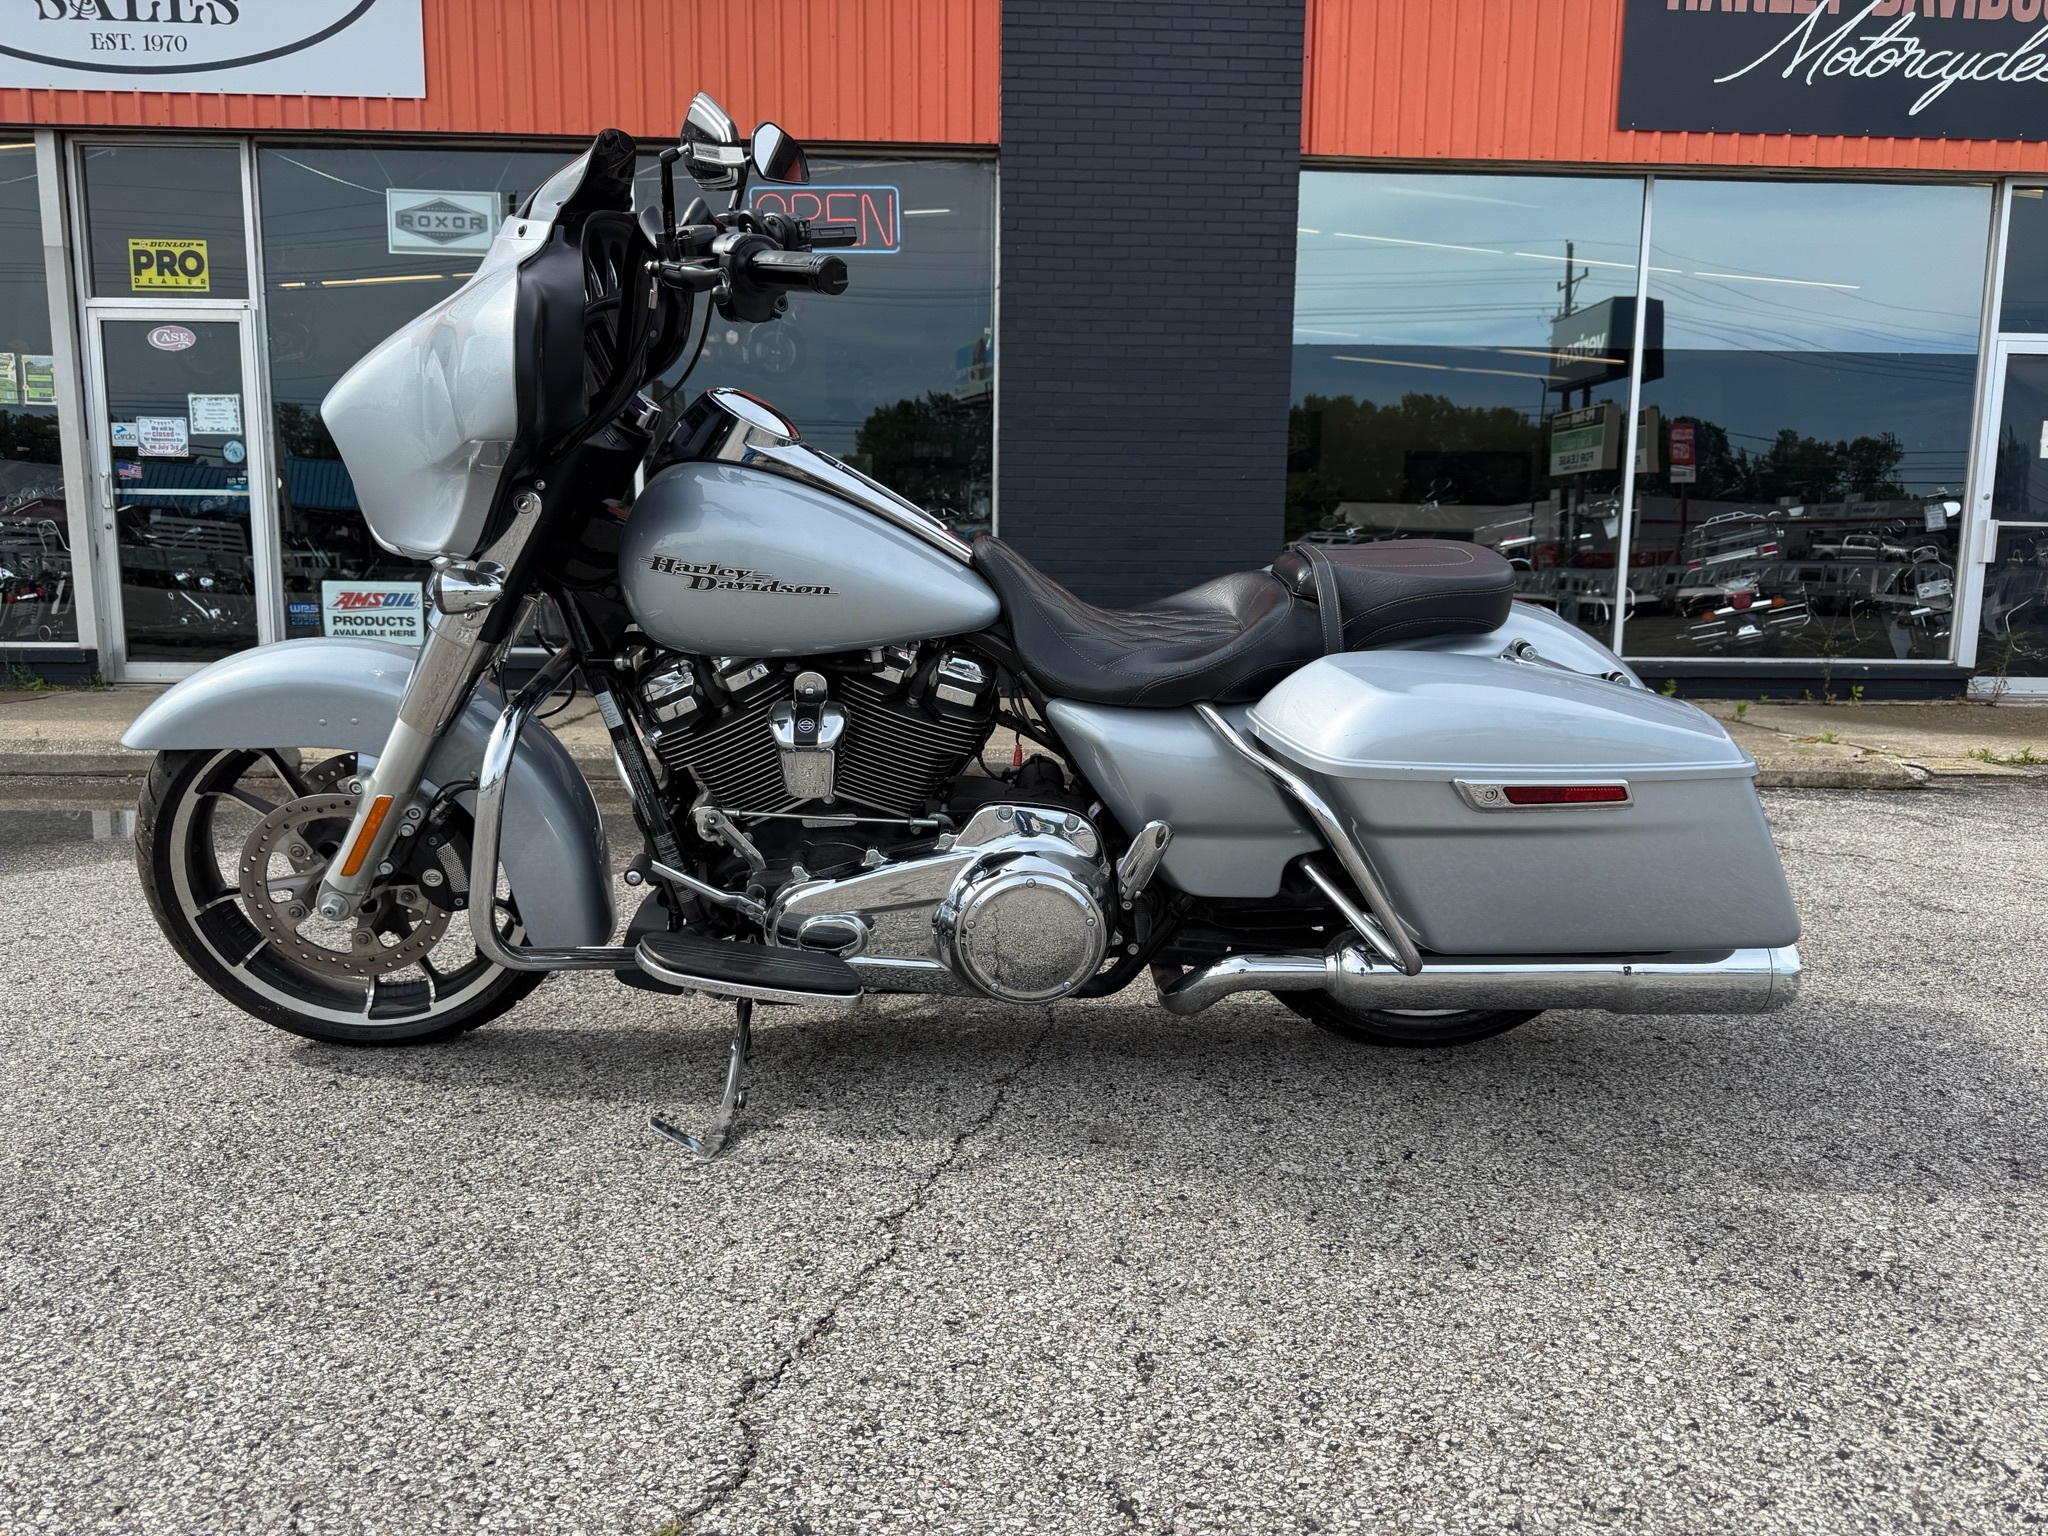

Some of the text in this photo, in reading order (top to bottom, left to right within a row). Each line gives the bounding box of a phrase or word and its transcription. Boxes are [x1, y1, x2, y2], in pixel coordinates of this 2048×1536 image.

[90, 32, 188, 52] EST. 1970
[400, 214, 483, 230] ROXOR
[132, 249, 205, 278] PRO
[134, 277, 206, 285] DEALER
[152, 329, 191, 347] CASE
[113, 432, 136, 440] cardo
[648, 553, 760, 582] Harley
[685, 573, 837, 596] Davidson
[288, 604, 320, 613] WPS
[332, 591, 417, 610] AMSOIL
[332, 615, 416, 627] PRODUCTS
[332, 629, 416, 637] AVAILABLE HERE
